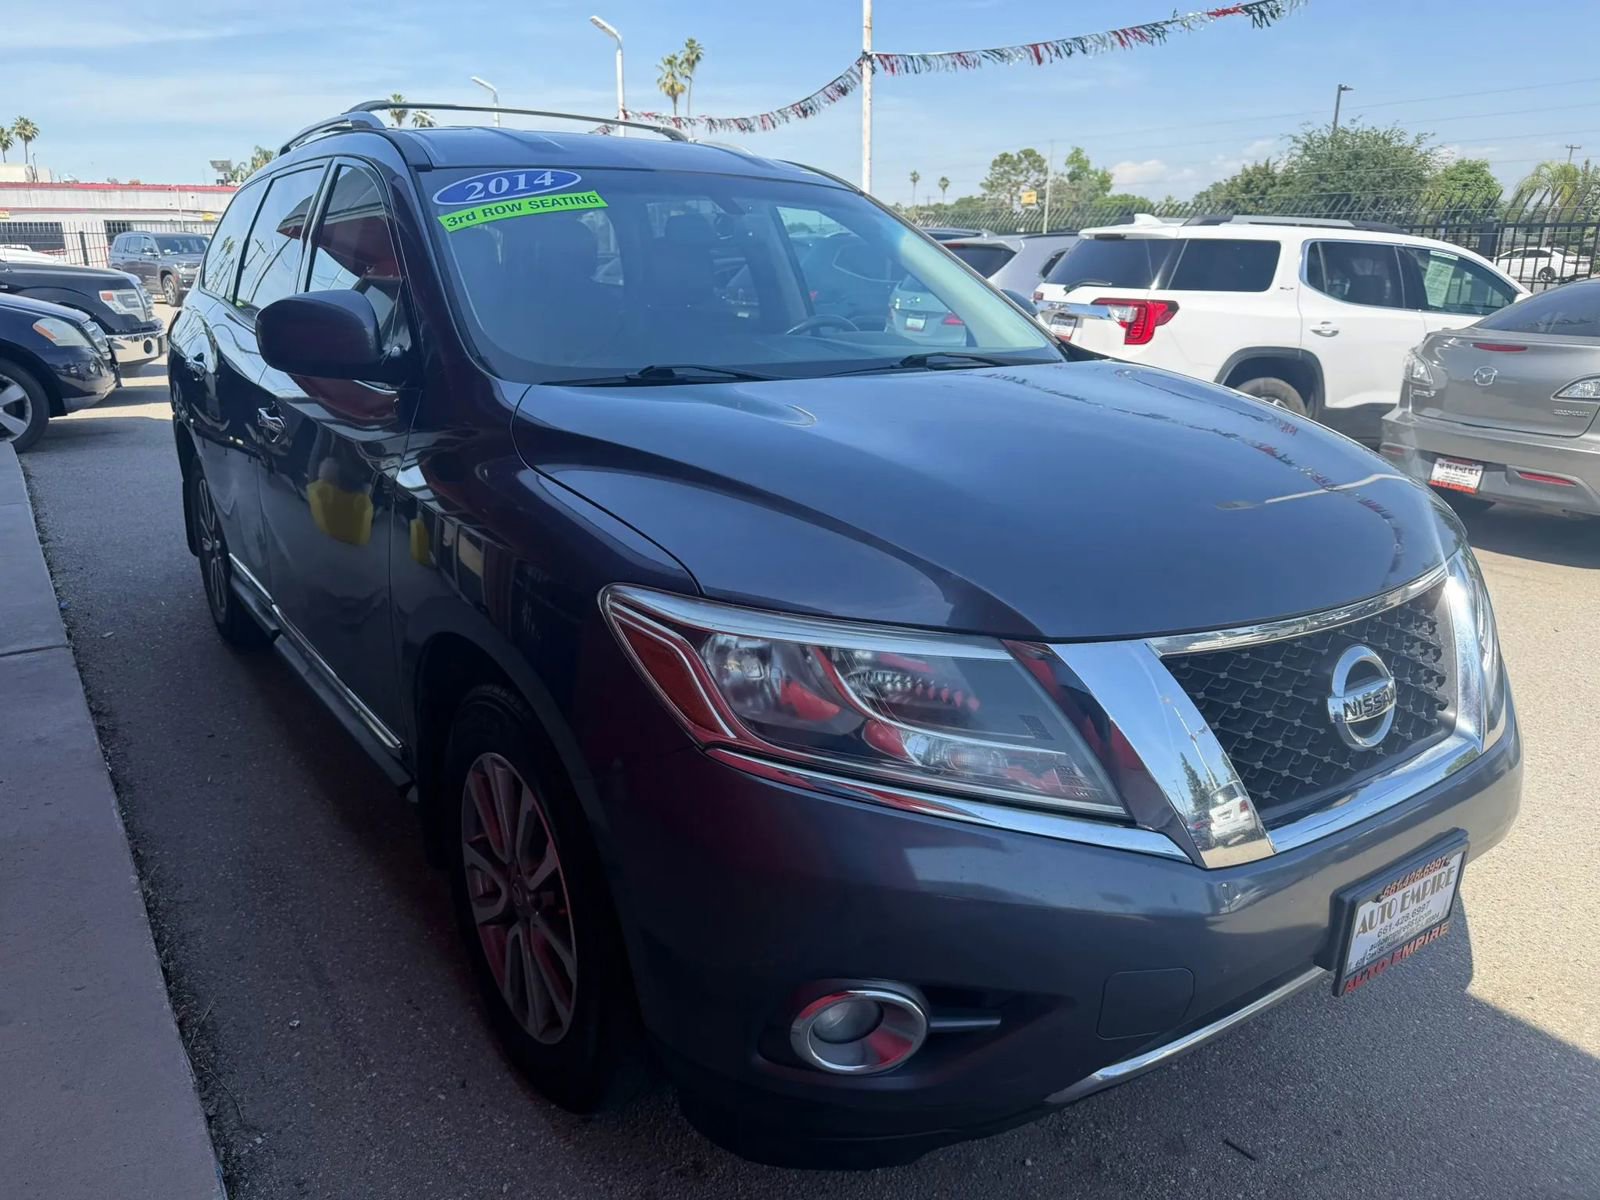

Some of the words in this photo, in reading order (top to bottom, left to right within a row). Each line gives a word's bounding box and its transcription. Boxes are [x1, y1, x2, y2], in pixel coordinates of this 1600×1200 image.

[446, 212, 476, 227] 3rd
[482, 203, 522, 217] ROW
[529, 193, 599, 209] SEATING
[465, 171, 554, 200] 2014
[1356, 898, 1398, 936] AUTO
[1400, 867, 1455, 913] EMPIRE
[1343, 958, 1389, 994] AUTO
[1391, 921, 1450, 965] EMPIRE
